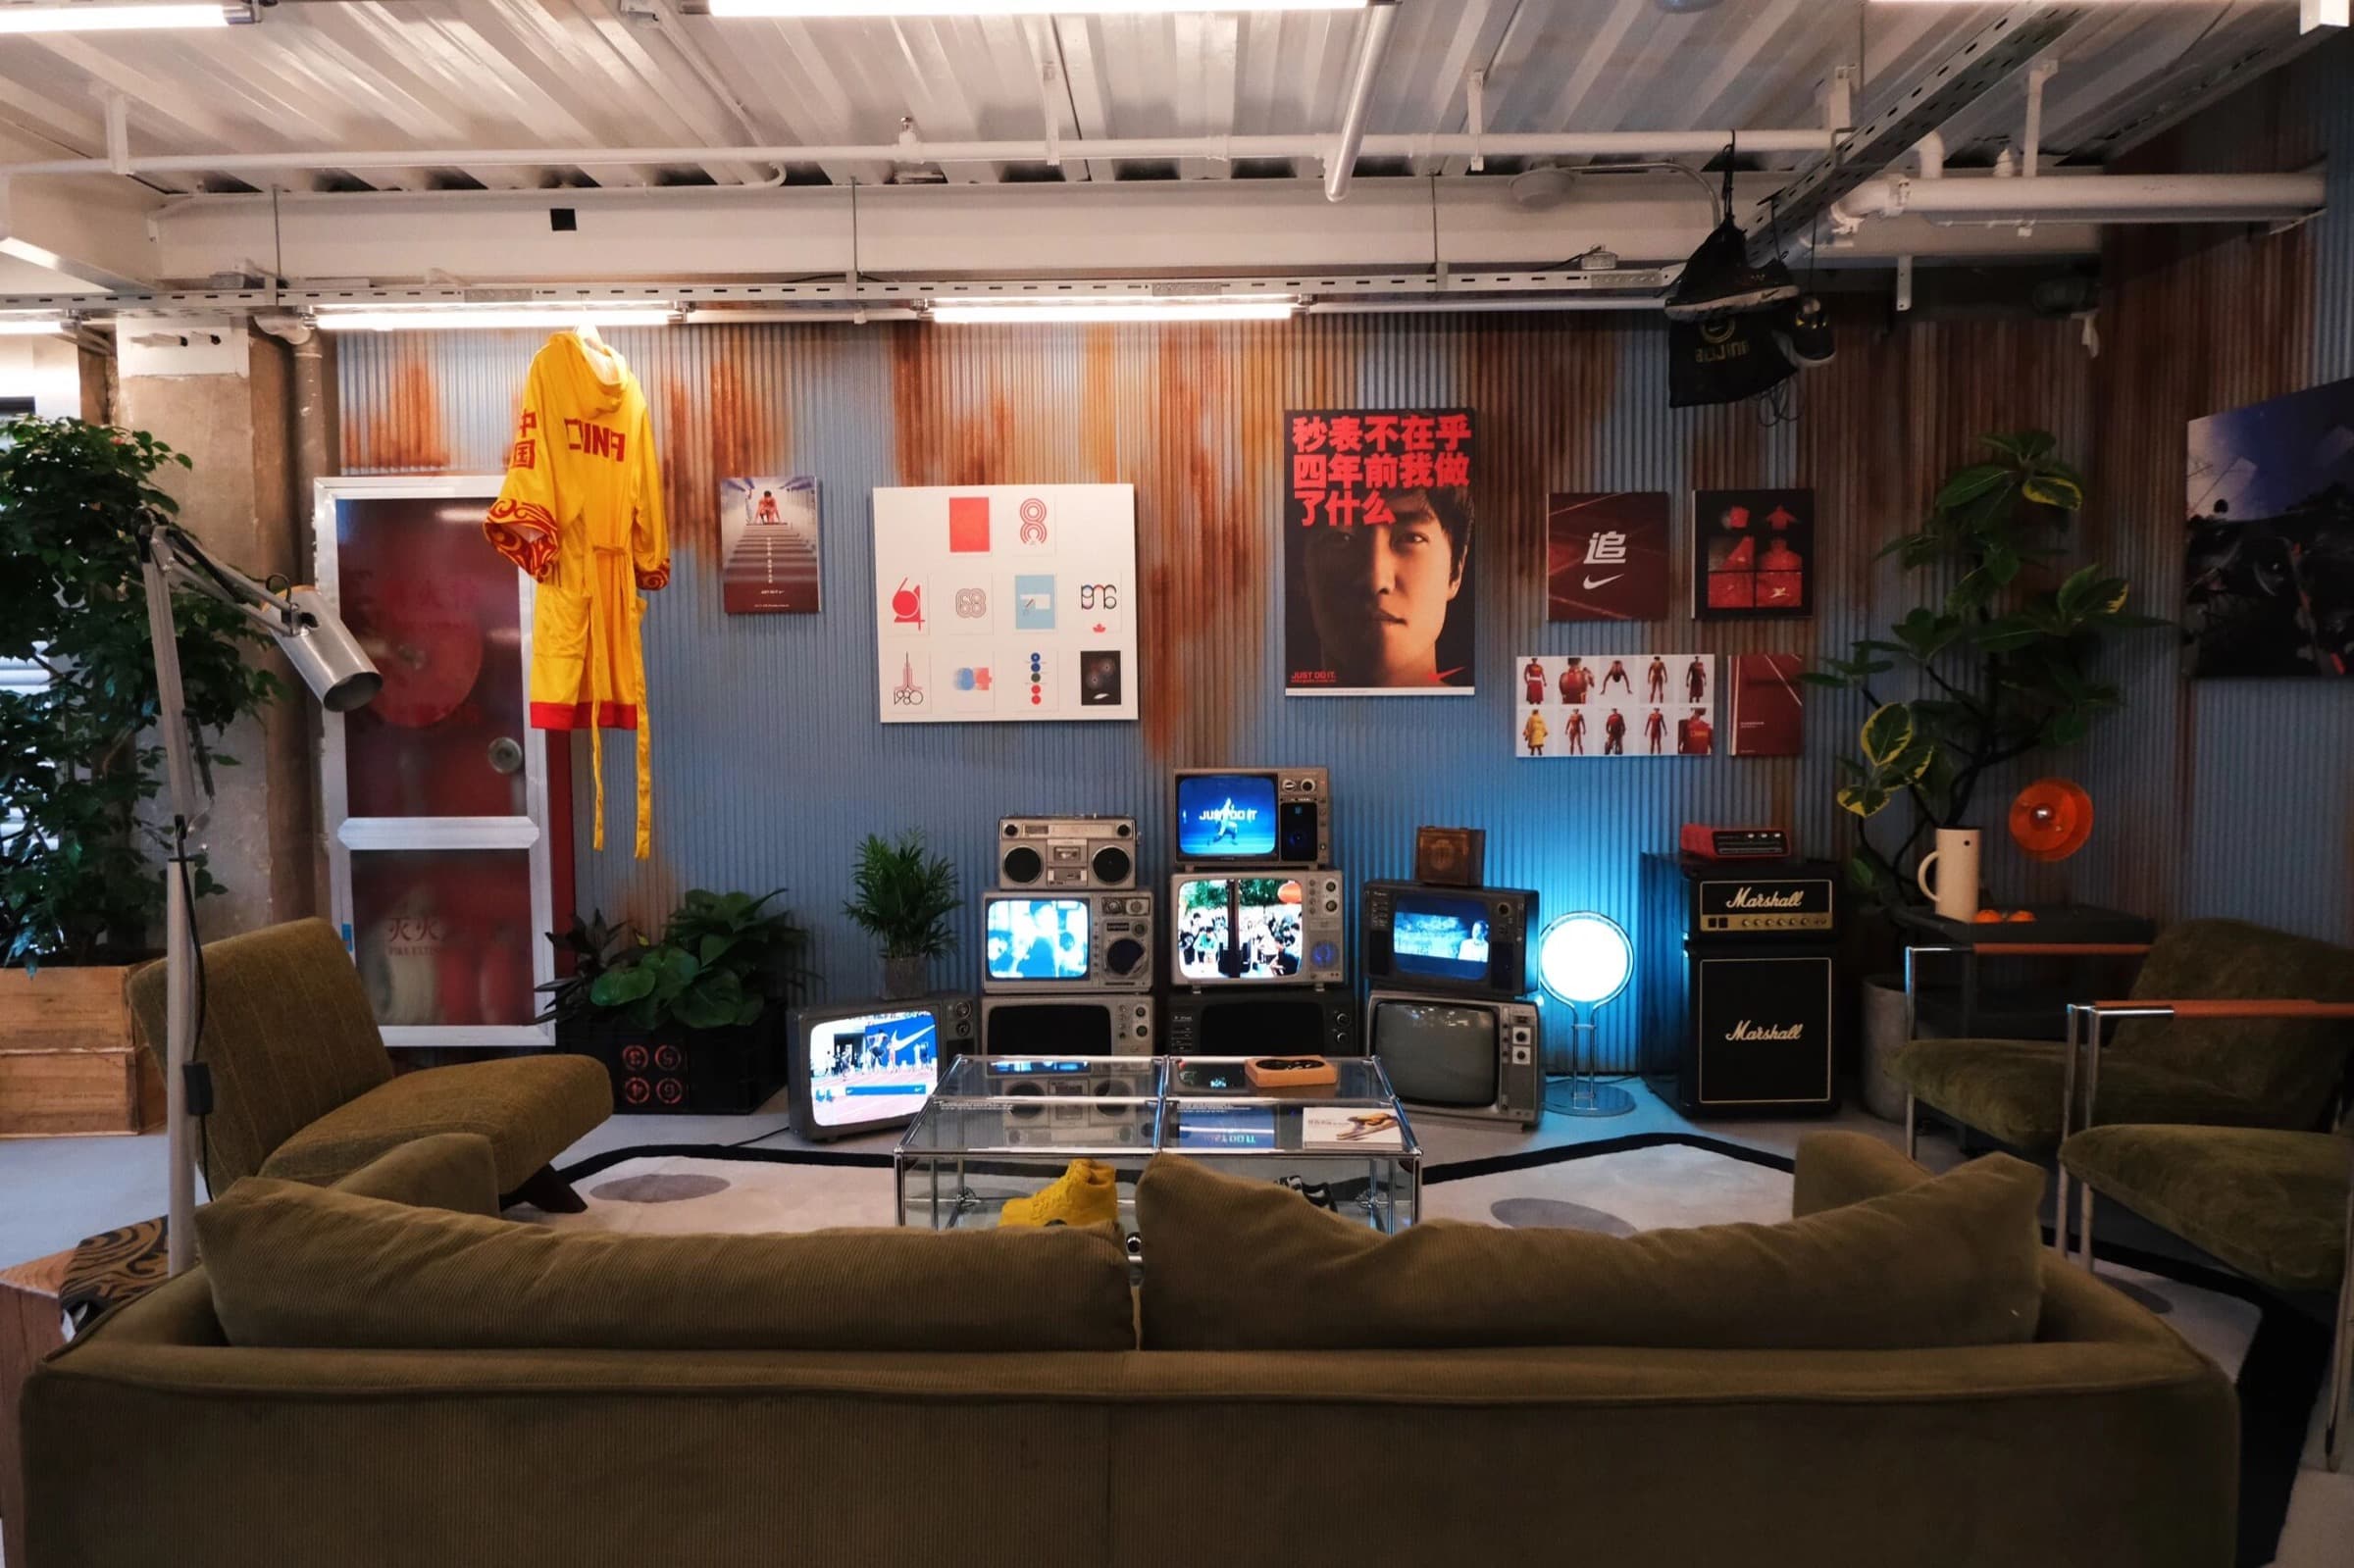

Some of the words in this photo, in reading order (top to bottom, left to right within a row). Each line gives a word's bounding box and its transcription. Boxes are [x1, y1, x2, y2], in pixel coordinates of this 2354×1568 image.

[511, 408, 537, 470] 中国
[1293, 414, 1471, 452] 秒表不在乎
[1293, 451, 1470, 488] 四年前我做
[1294, 489, 1397, 527] 了什么
[1583, 531, 1626, 564] 追
[1229, 809, 1245, 821] DO
[1247, 809, 1257, 821] IT
[1726, 886, 1804, 908] Marshall
[1725, 1020, 1804, 1040] Marshall
